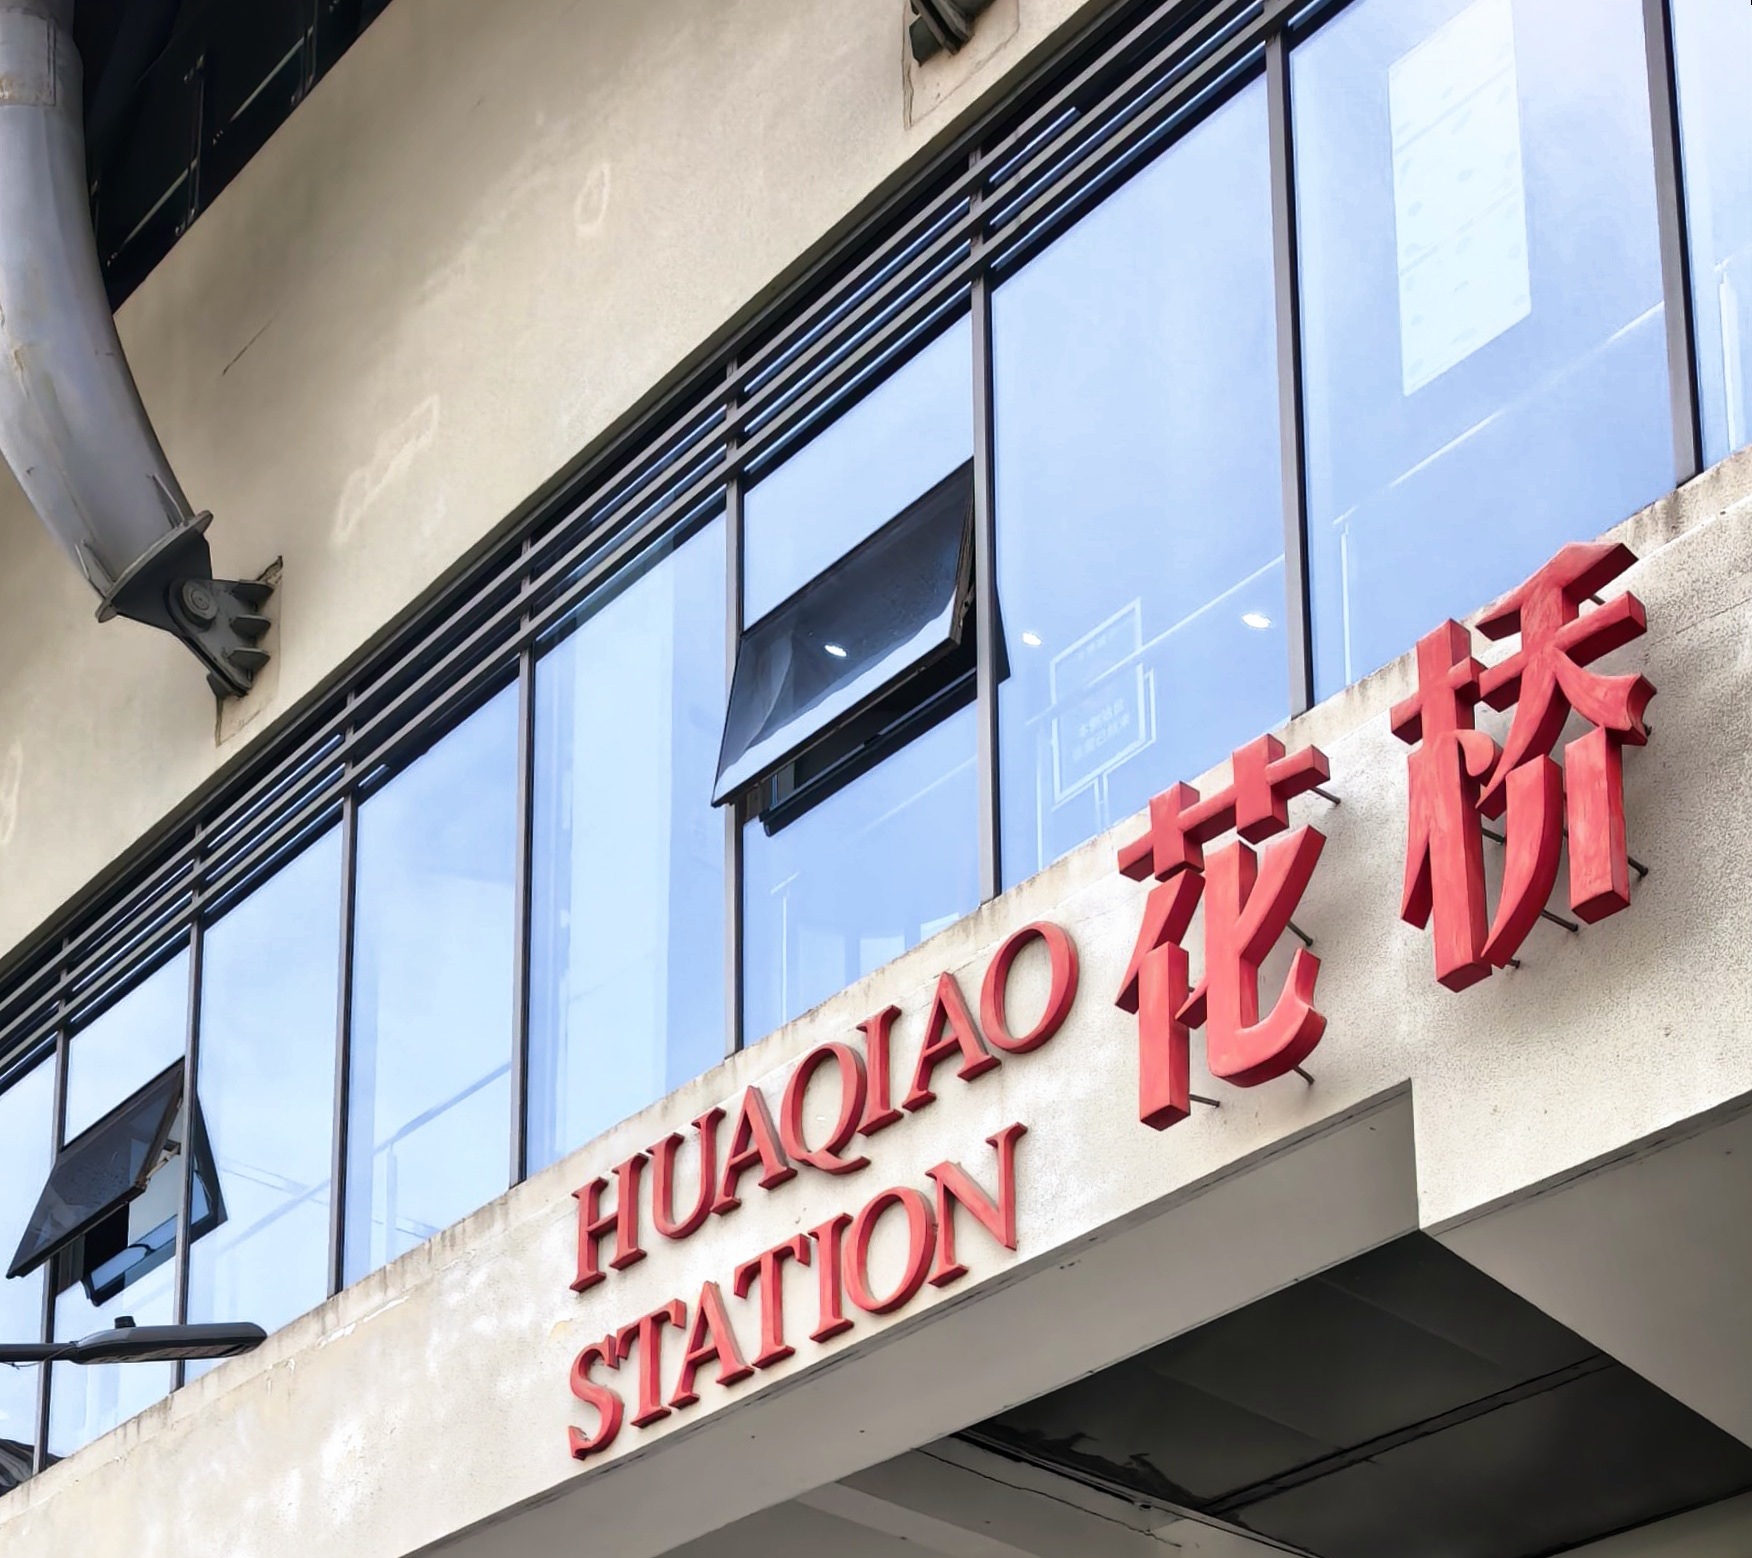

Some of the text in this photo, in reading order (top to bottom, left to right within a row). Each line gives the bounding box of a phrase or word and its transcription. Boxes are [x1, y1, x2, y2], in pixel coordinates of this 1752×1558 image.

[1115, 542, 1657, 1131] 花桥
[568, 1122, 1029, 1460] STATION
[570, 921, 1080, 1293] HUAQIAO
